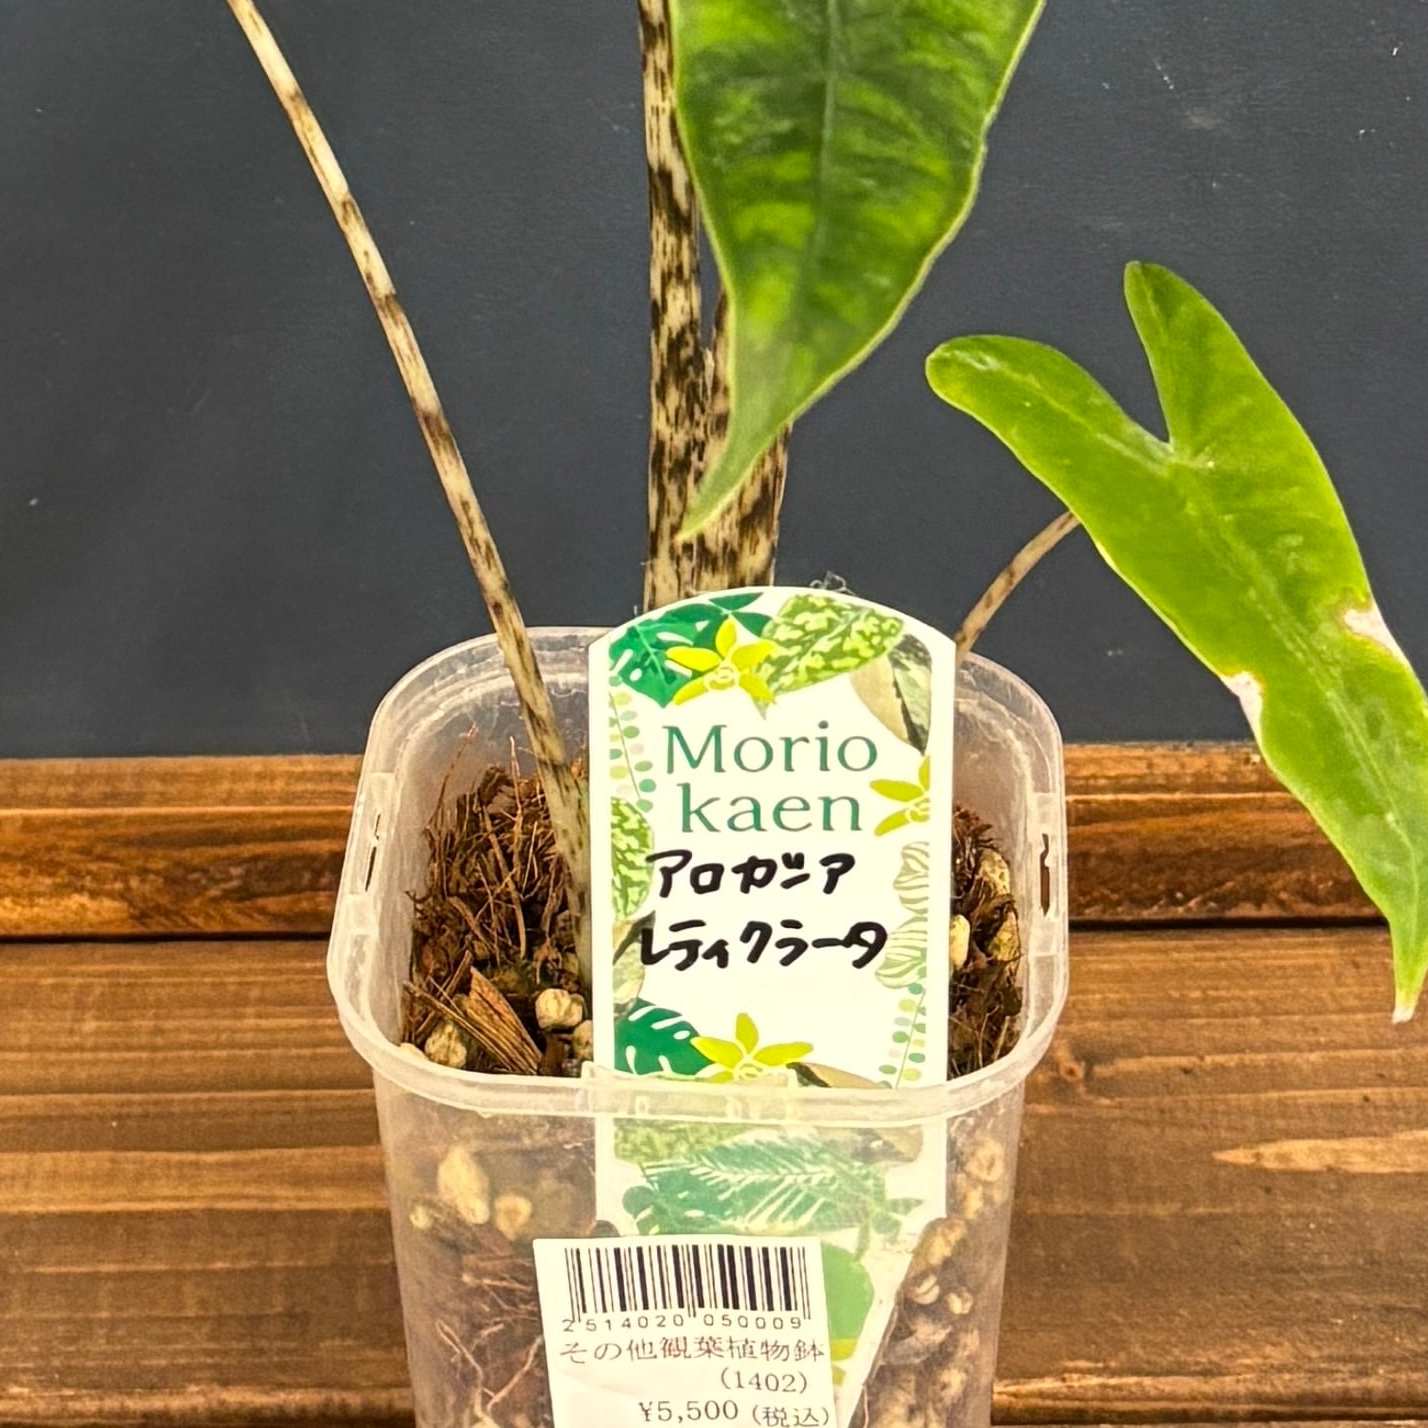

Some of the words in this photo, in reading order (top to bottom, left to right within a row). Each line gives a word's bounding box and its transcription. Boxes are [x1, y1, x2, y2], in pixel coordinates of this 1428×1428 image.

[662, 721, 878, 774] Morio
[677, 783, 862, 832] kaen
[640, 920, 888, 971] レティクラータ
[560, 1336, 825, 1364] その他観葉植物鉢
[720, 1367, 808, 1395] (1402)
[639, 1400, 739, 1424] ¥5,500
